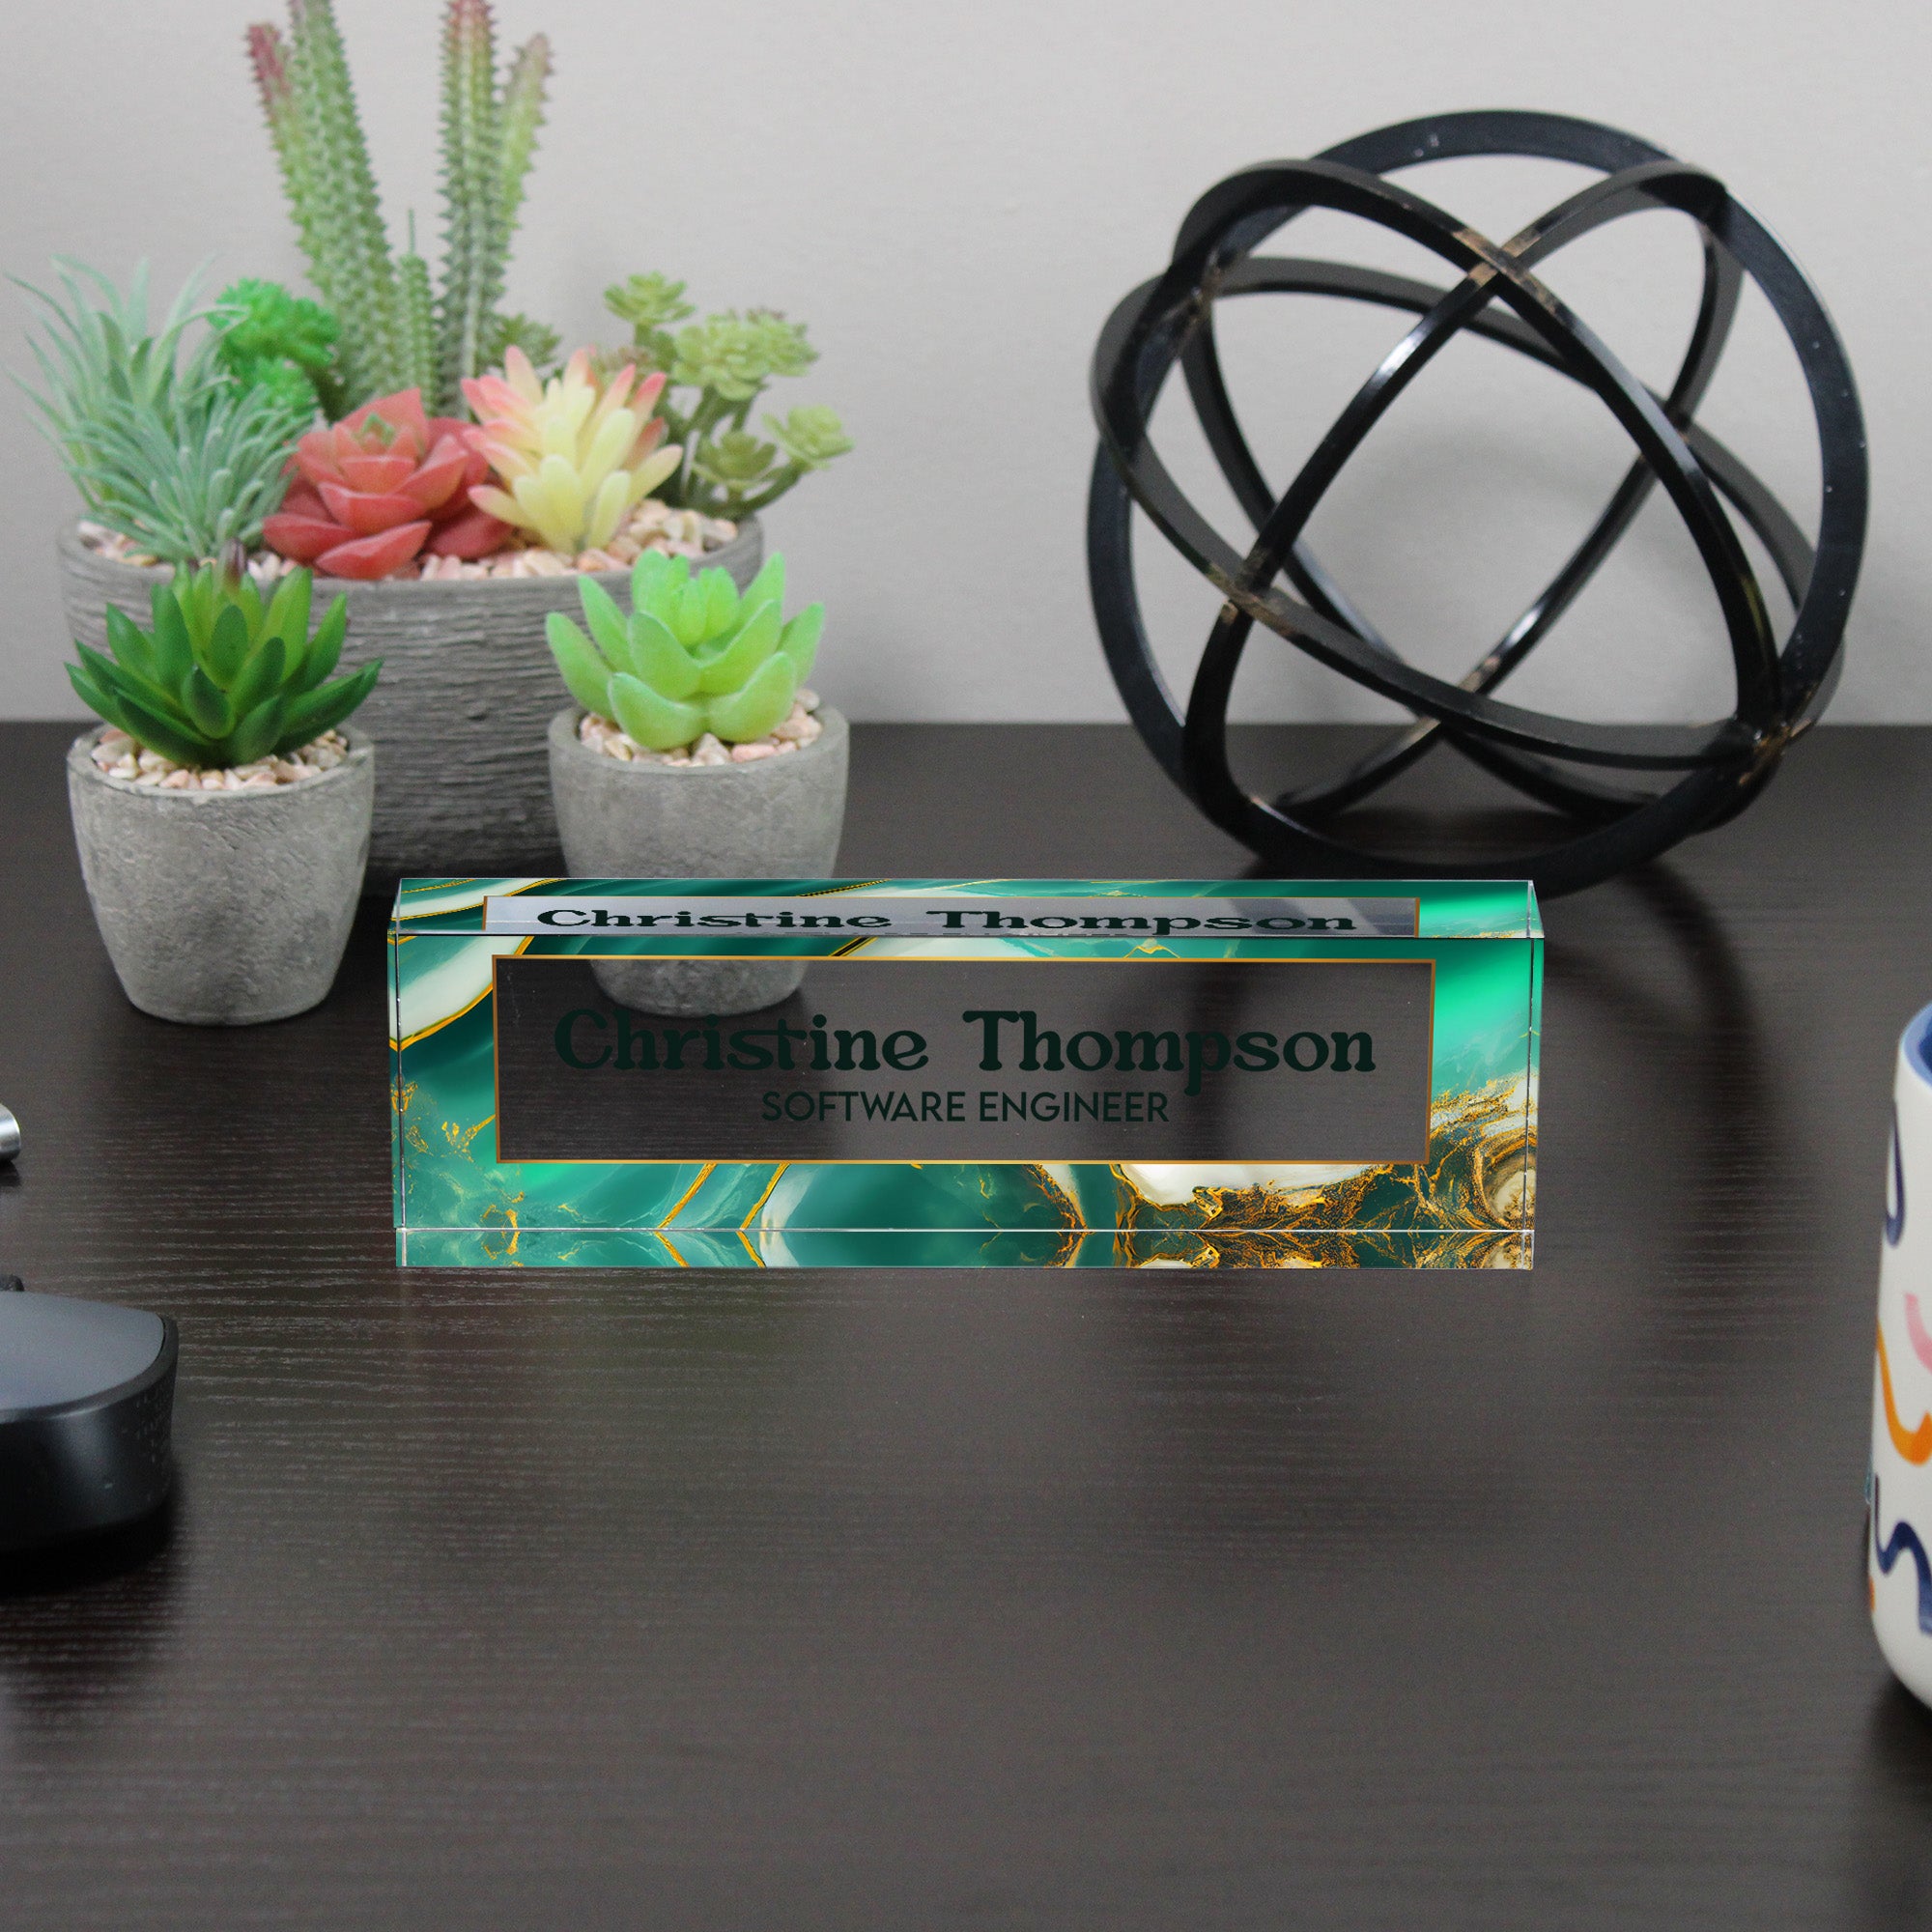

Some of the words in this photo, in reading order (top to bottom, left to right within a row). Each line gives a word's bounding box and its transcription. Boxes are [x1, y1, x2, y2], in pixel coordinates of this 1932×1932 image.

[537, 909, 891, 928] Christine
[925, 910, 1356, 936] Thompson
[554, 1009, 928, 1071] Christine
[962, 1010, 1376, 1096] Thompson
[761, 1091, 966, 1122] SOFTWARE
[979, 1091, 1169, 1122] ENGINEER
